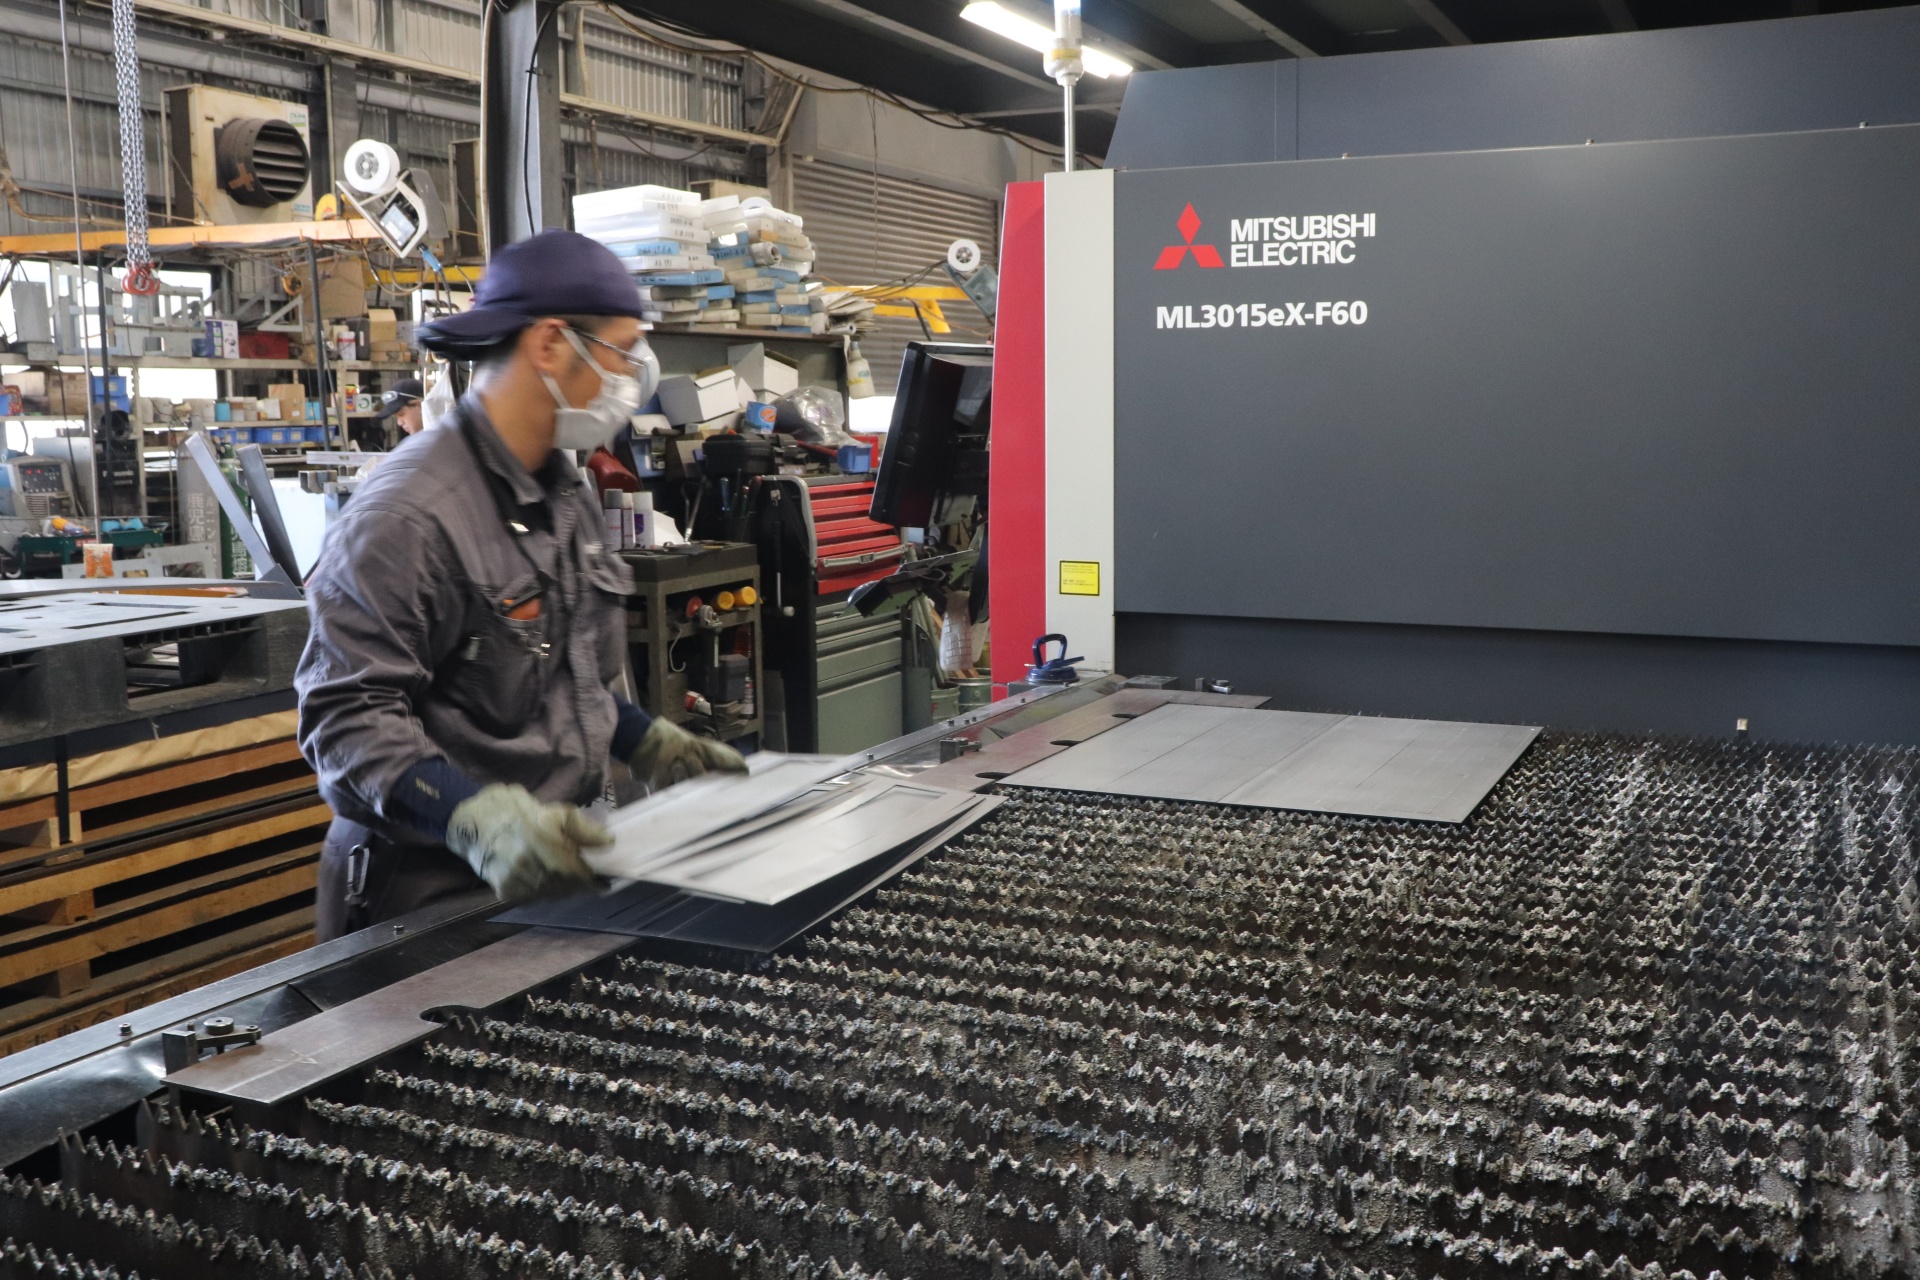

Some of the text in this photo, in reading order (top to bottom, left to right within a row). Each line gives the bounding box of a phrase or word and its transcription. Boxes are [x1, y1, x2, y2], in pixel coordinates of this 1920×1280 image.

[1231, 213, 1376, 242] MITSUBISHI
[1231, 240, 1356, 267] ELECTRIC
[1156, 301, 1368, 329] ML3015eX-F60
